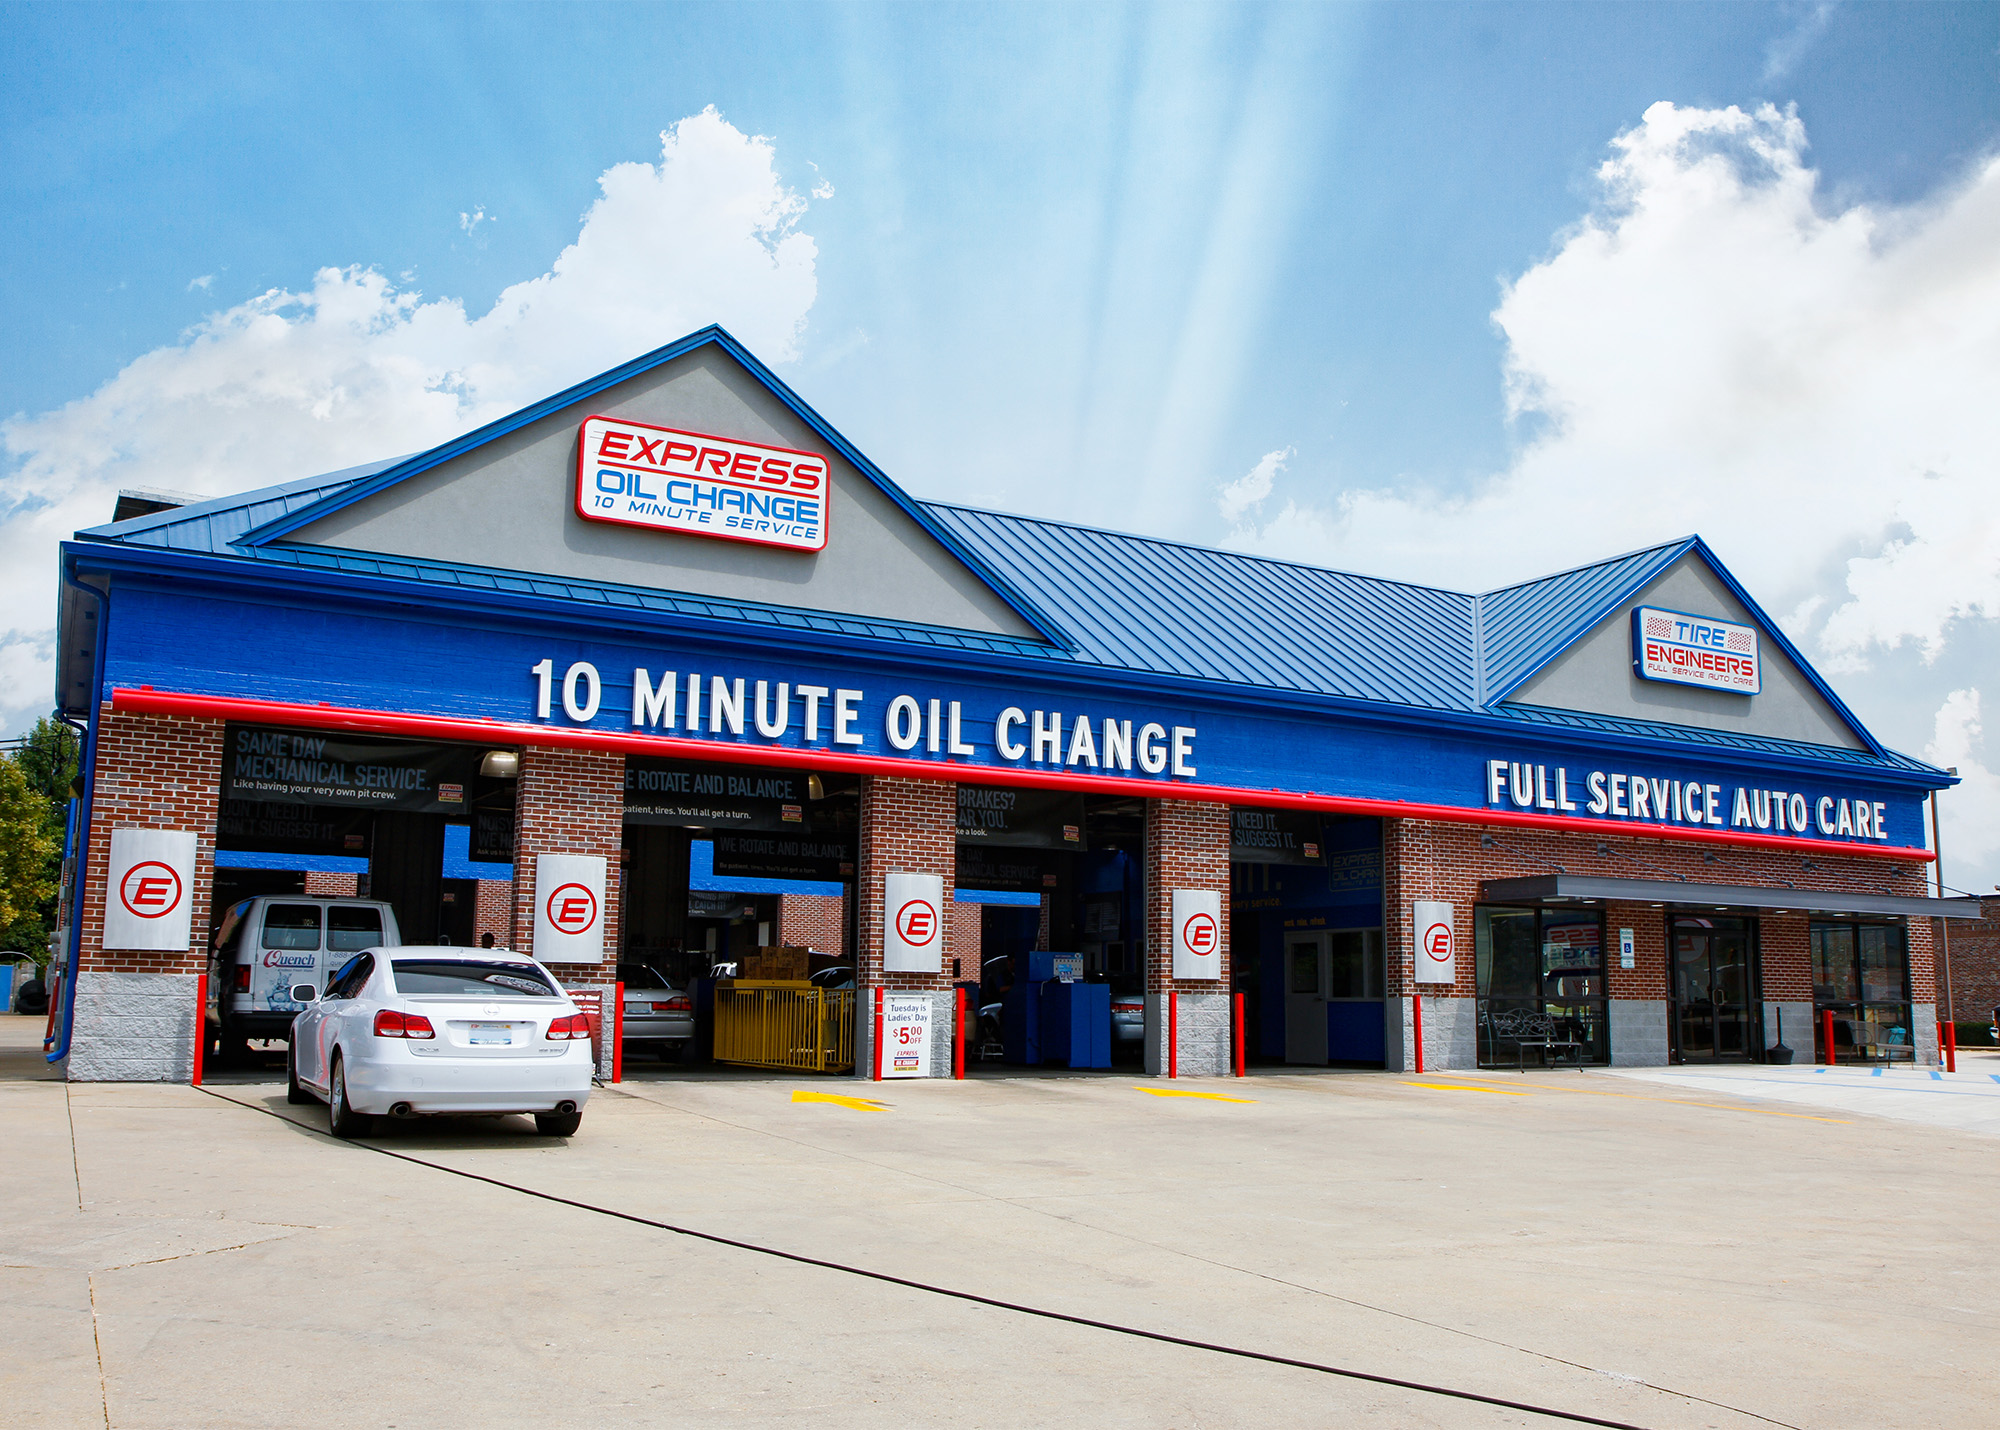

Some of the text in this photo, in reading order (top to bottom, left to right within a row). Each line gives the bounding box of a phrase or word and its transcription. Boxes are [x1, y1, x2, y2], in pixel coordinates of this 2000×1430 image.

[597, 430, 823, 491] EXPRESS
[596, 469, 819, 525] OIL CHANGE
[594, 495, 819, 540] 10 MINUTE SERVICE
[1675, 621, 1726, 647] TIRE
[1647, 643, 1754, 677] ENGINEERS
[1647, 663, 1754, 687] FULL SERVICE AUTO CARE
[531, 658, 1197, 777] 10 MINUTE OIL CHANGE
[236, 730, 327, 760] SAME DAY
[234, 755, 431, 791] MECHANICAL SERVICE.
[233, 778, 397, 800] Like having your very own pit crew.
[638, 770, 691, 793] ROTATE
[693, 775, 725, 796] AND
[728, 777, 797, 800] BALANCE.
[958, 788, 1016, 810] BRAKES?
[1487, 760, 1888, 839] FULL SERVICE AUTO CARE
[265, 802, 300, 820] NEED
[655, 806, 676, 815] tires.
[677, 807, 699, 817] You'll
[700, 807, 711, 817] all
[712, 809, 725, 819] get
[732, 811, 752, 819] turn.
[977, 809, 1009, 829] YOU.
[1237, 811, 1264, 829] NEED
[1265, 813, 1278, 830] IT.
[258, 818, 319, 840] SUGGEST
[970, 828, 988, 837] look.
[1235, 829, 1282, 848] SUGGEST
[1283, 832, 1297, 848] IT.
[720, 837, 737, 852] WE
[739, 838, 775, 855] ROTATE
[776, 841, 799, 856] AND
[133, 878, 172, 905] E
[559, 899, 590, 924] E
[907, 914, 932, 936] E
[1193, 926, 1213, 947] E
[1432, 935, 1449, 953] E
[263, 950, 315, 968] Quench
[887, 1013, 928, 1022] Ladies' Day
[890, 1004, 919, 1013] Tuesday
